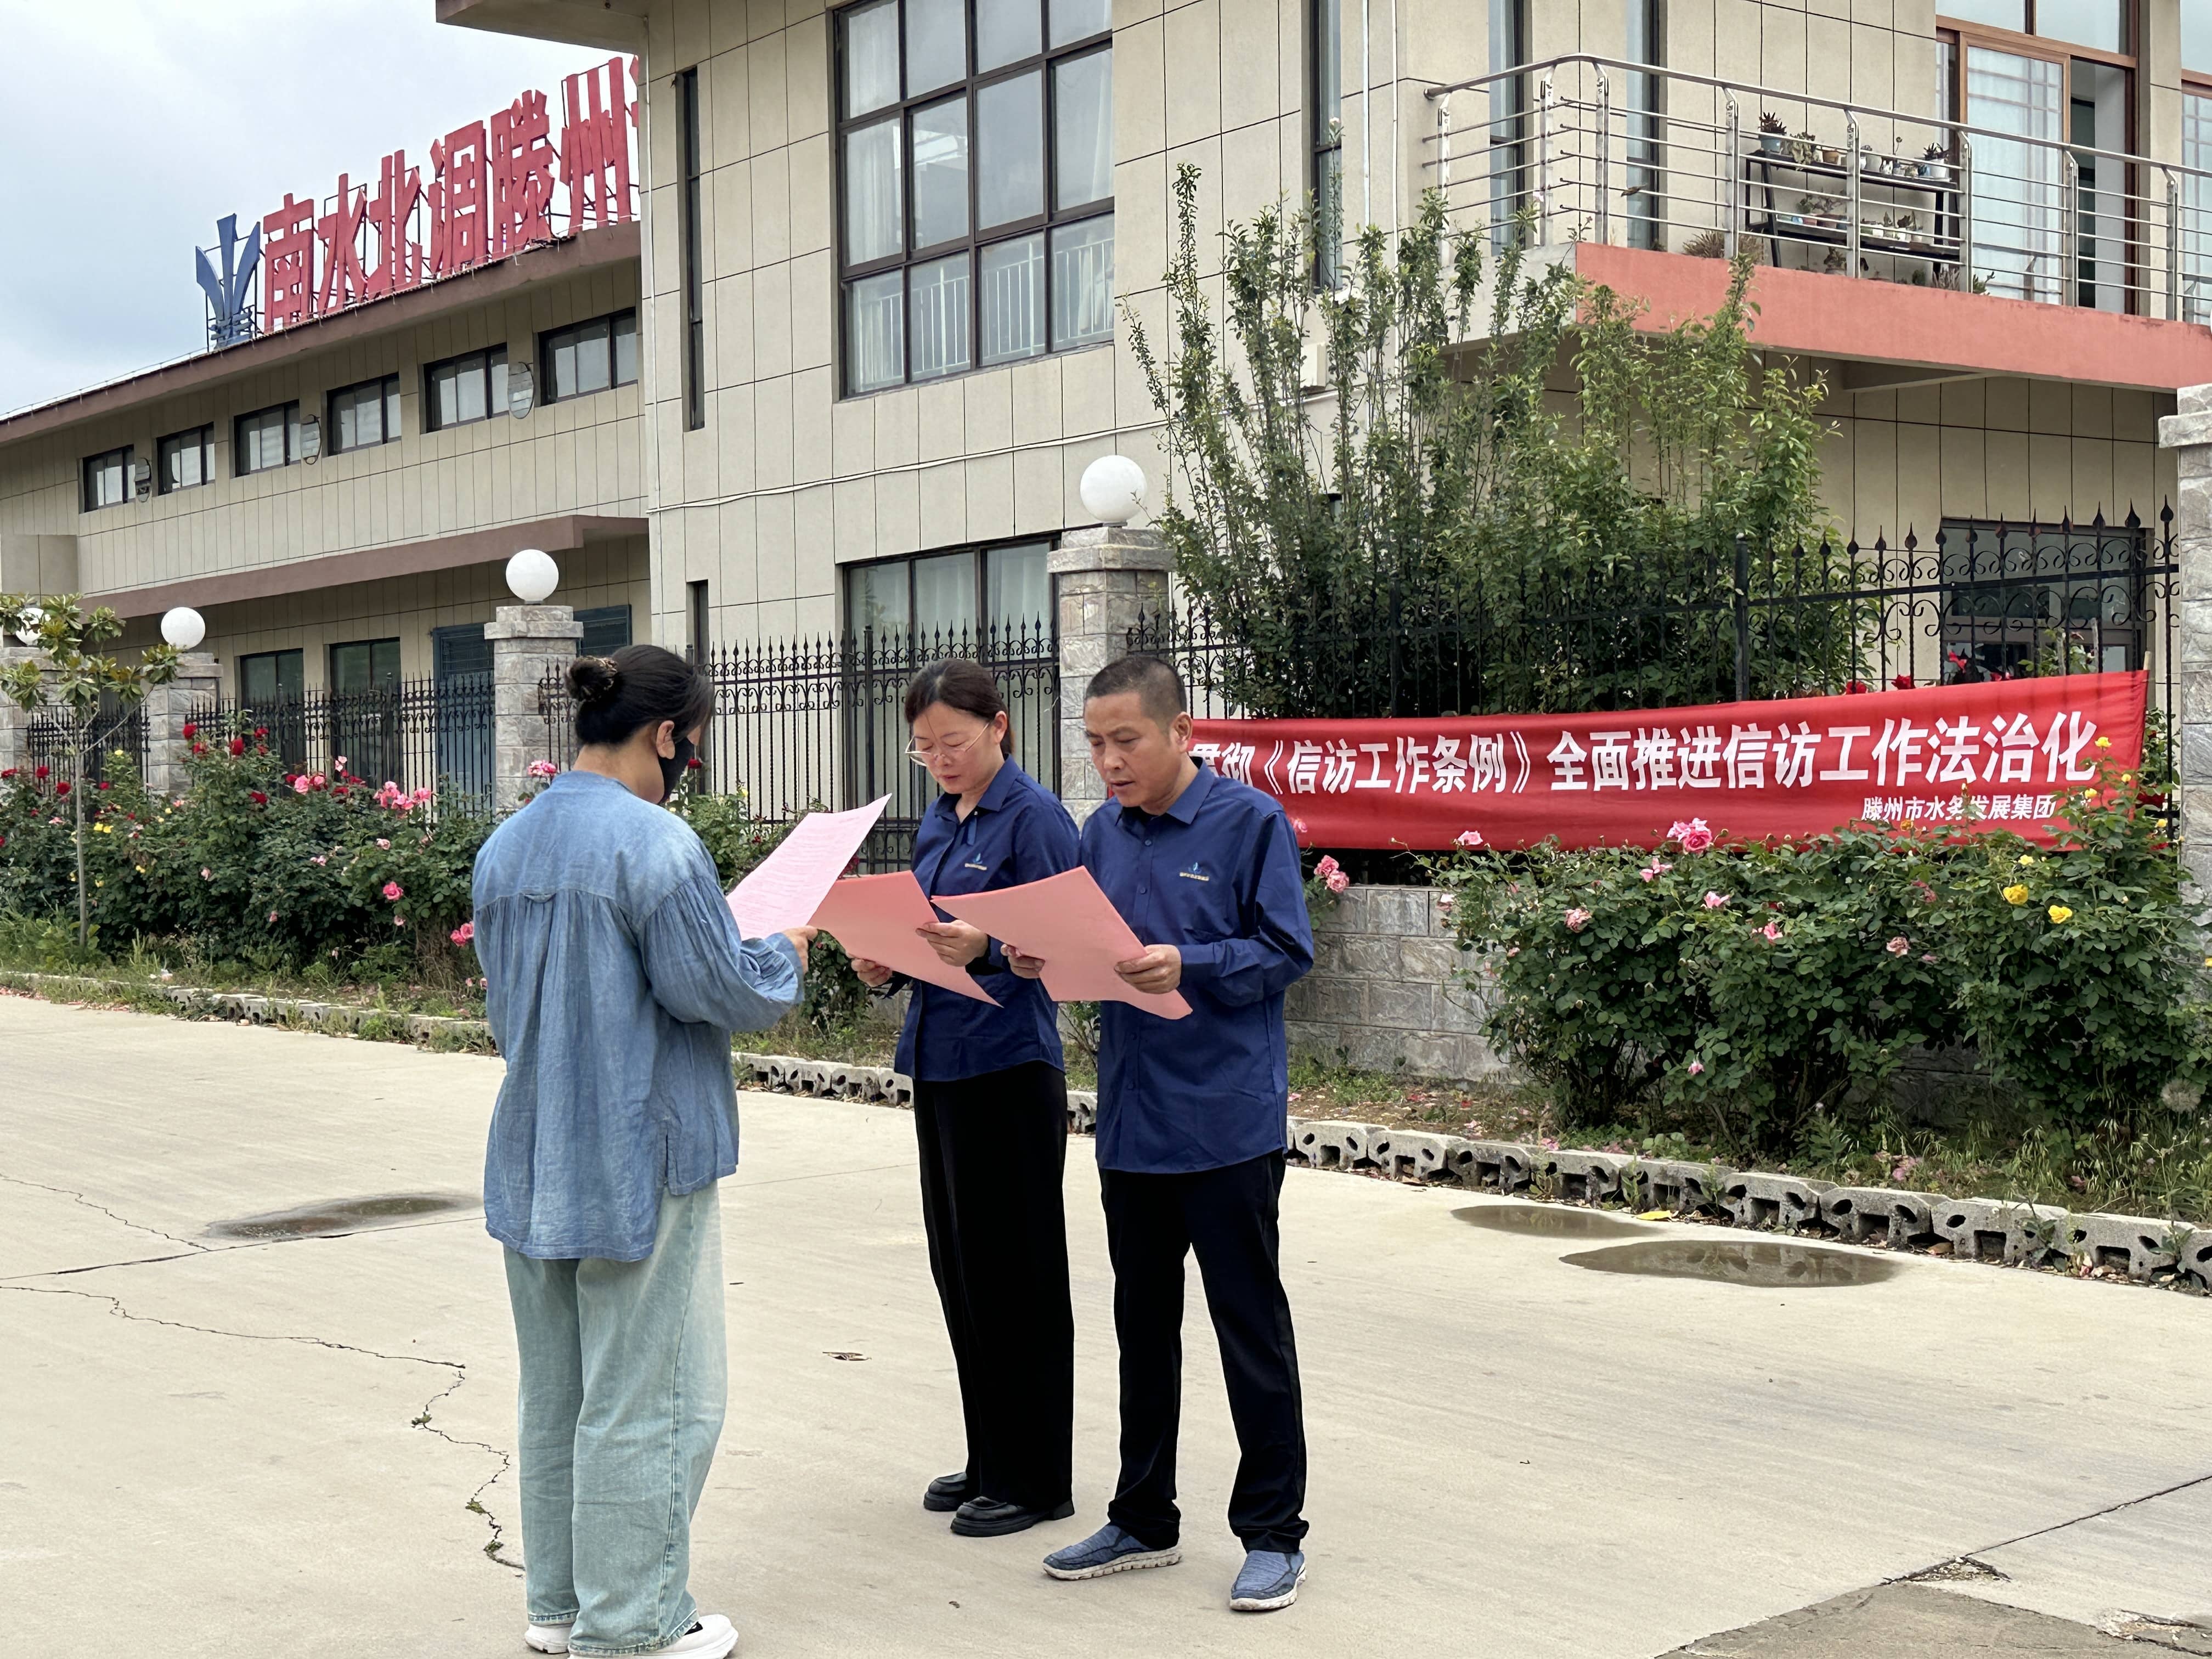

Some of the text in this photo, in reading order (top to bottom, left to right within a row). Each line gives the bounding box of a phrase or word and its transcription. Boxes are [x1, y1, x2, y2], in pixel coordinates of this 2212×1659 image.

[263, 55, 639, 334] 南水北调滕州
[1861, 794, 2057, 821] 滕州市水务发展集团
